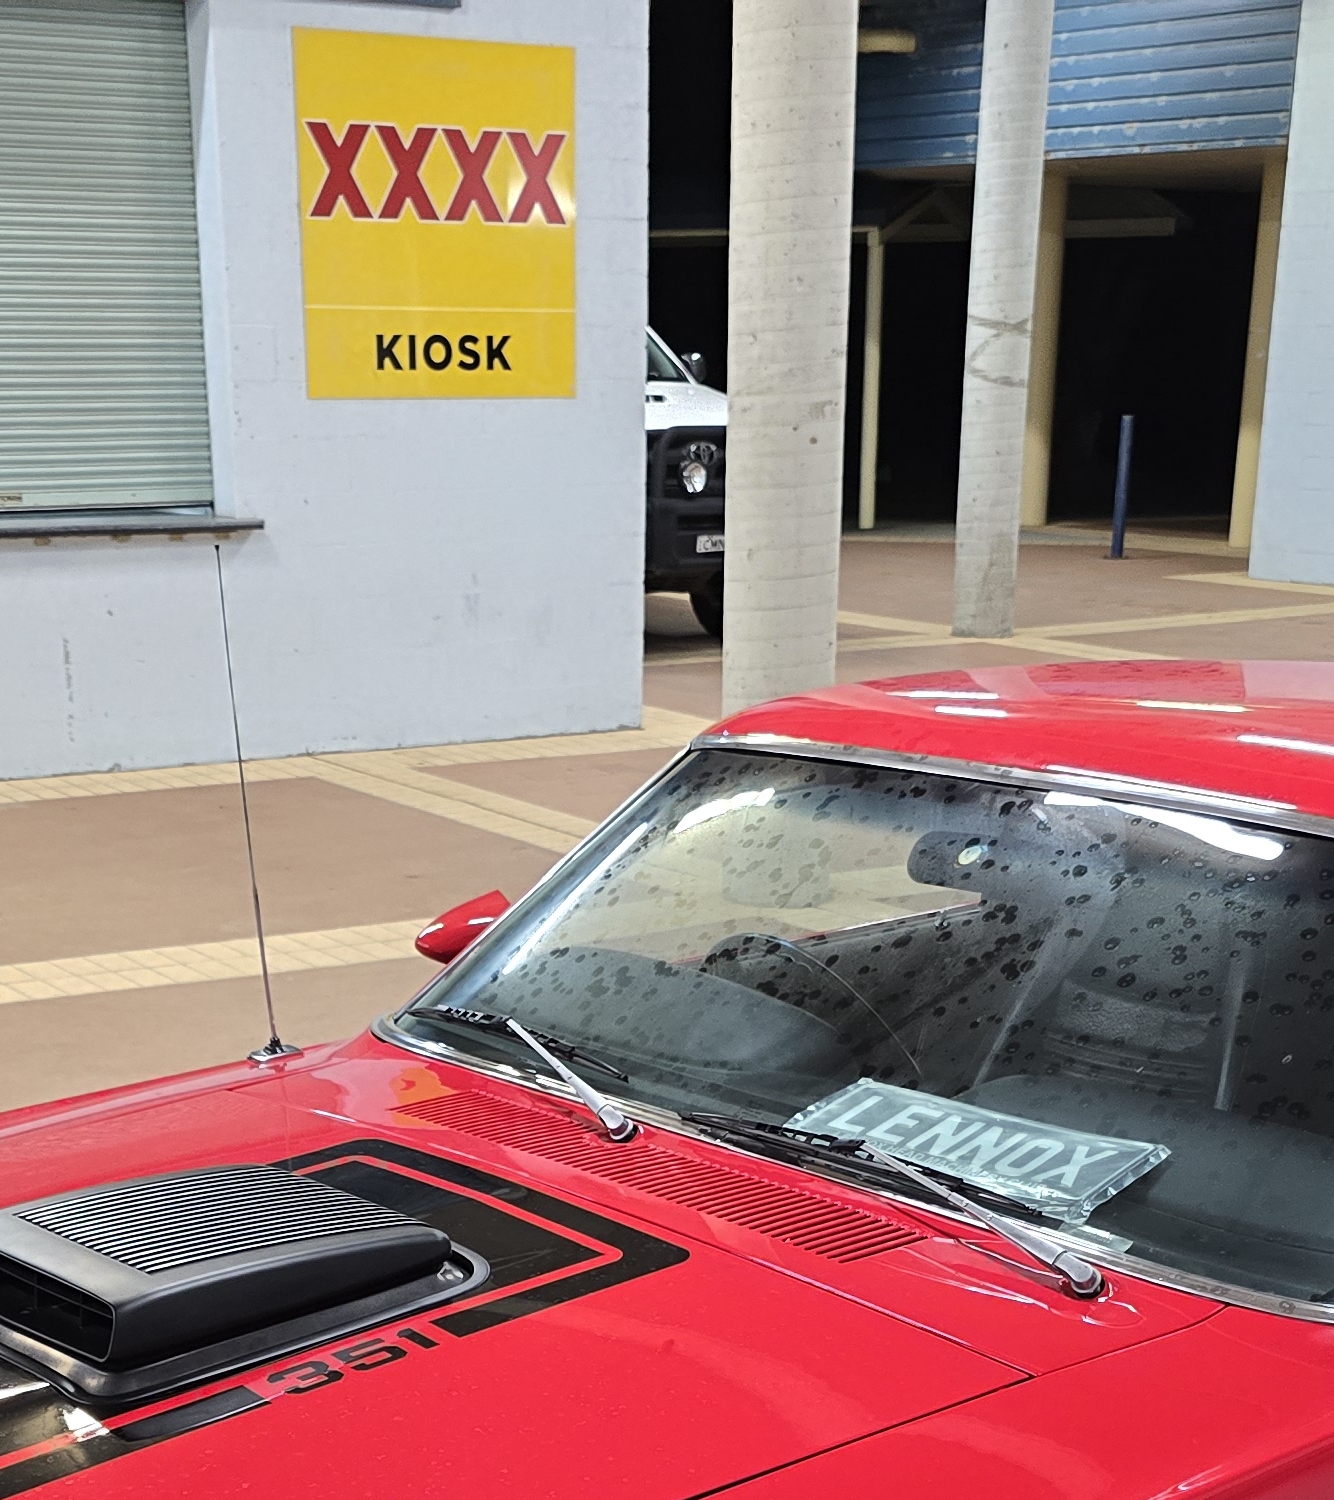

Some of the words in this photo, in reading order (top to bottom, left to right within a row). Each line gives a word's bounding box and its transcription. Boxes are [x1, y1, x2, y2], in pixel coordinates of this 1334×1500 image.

[303, 119, 569, 227] XXXX
[375, 334, 512, 372] KIOSK
[827, 1094, 1120, 1189] LENNOX
[887, 1145, 926, 1160] HEAD
[267, 1327, 441, 1395] 351
